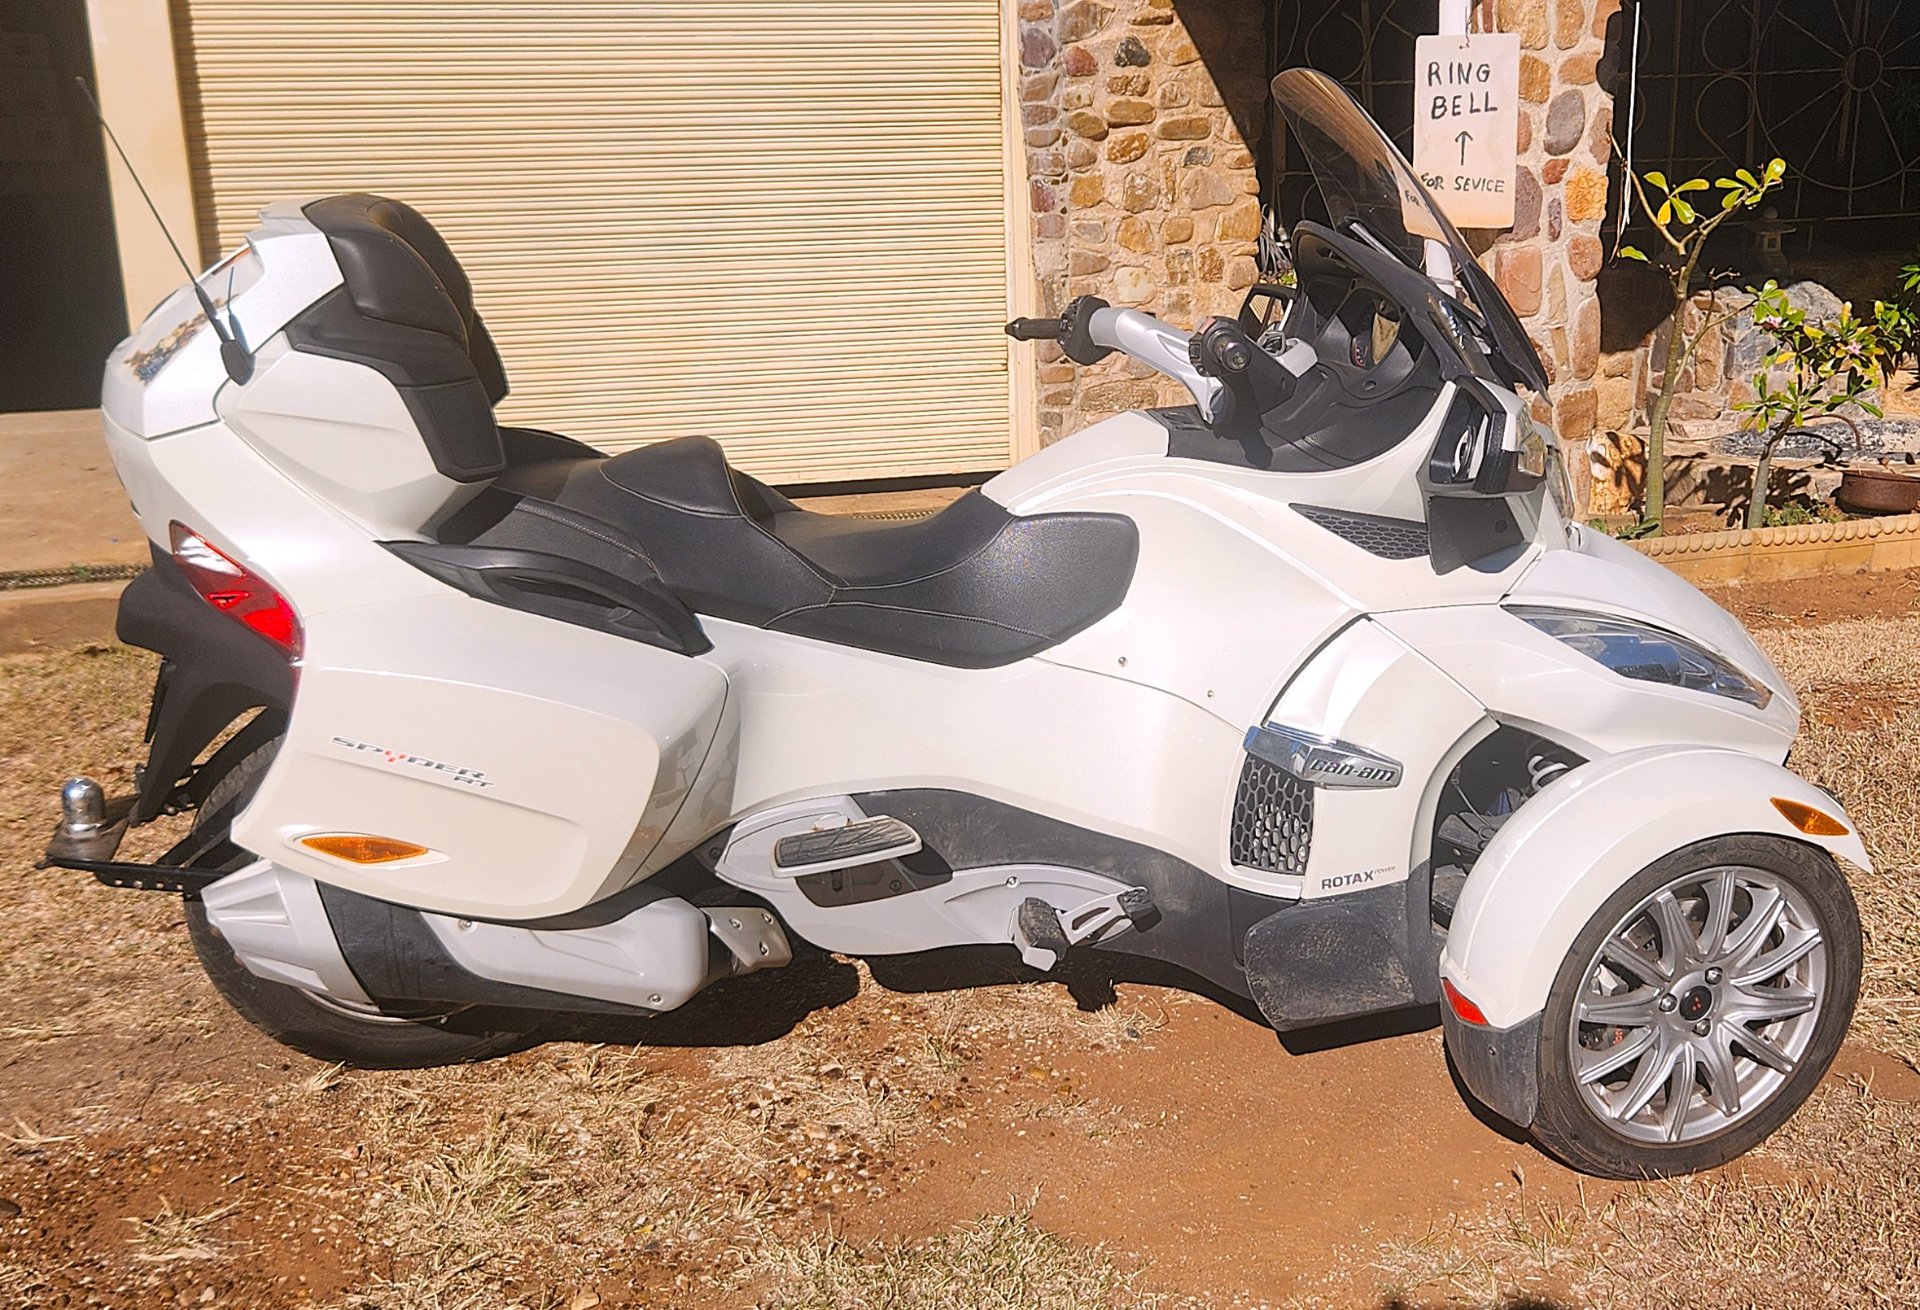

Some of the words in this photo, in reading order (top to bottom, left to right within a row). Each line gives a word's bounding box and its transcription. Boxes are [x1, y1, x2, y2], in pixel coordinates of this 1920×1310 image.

[1428, 62, 1491, 87] RING
[1431, 91, 1498, 120] BELL
[1454, 175, 1505, 193] SEVICE
[330, 736, 486, 779] SPYDER
[1310, 759, 1396, 782] can-am
[1321, 870, 1374, 890] ROTAX
